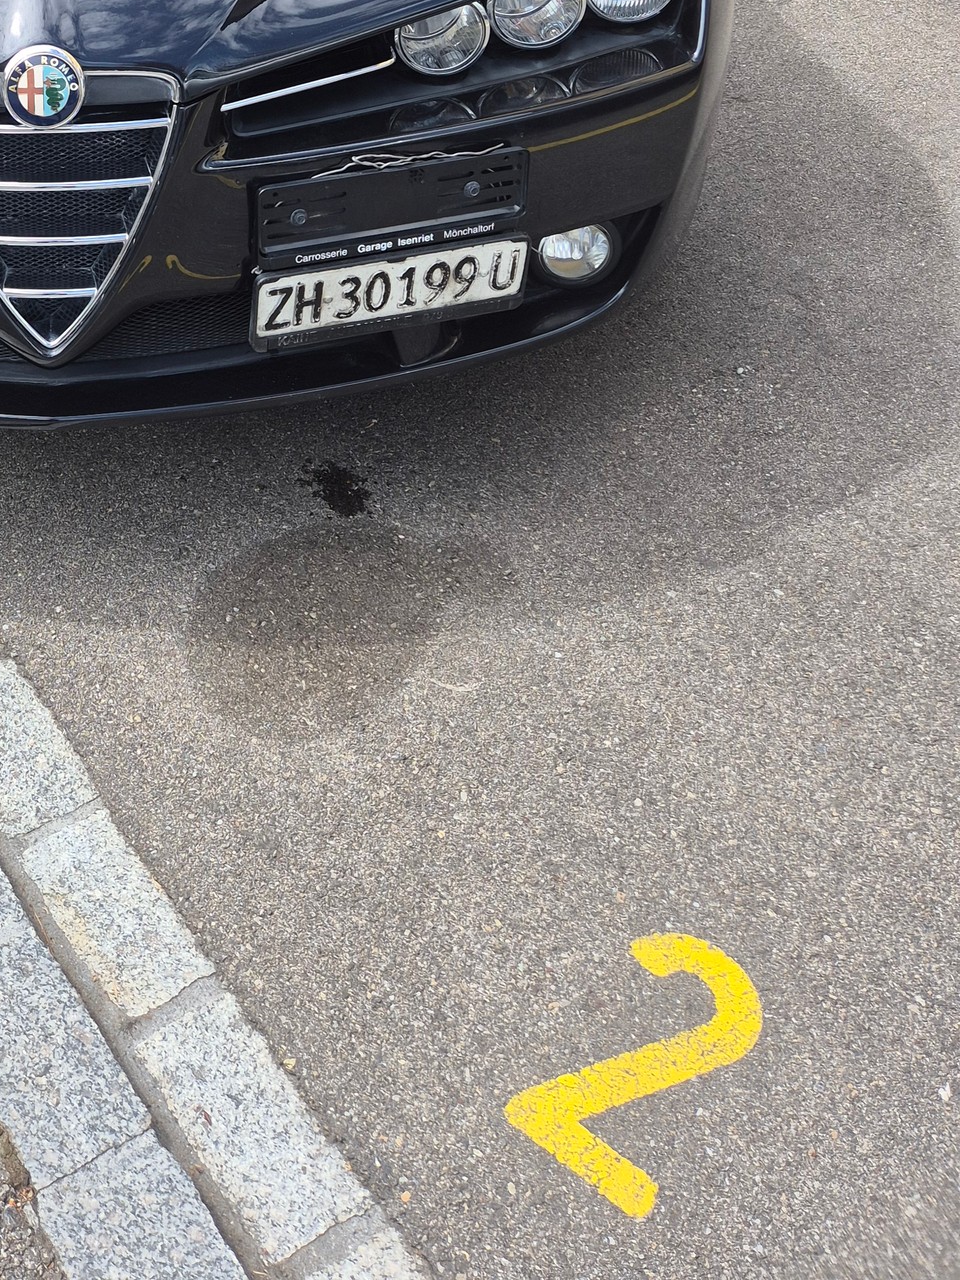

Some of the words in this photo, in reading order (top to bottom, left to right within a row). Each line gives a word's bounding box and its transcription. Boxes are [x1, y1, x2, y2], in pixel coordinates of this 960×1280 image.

[8, 59, 34, 93] ALFA
[41, 55, 79, 91] ROMEO
[295, 248, 348, 264] Carrosserie
[357, 240, 393, 254] Garage
[397, 233, 434, 248] Isenriet
[443, 223, 495, 239] Mönchaltorf
[265, 280, 325, 331] ZH
[333, 255, 481, 320] 30199
[489, 248, 521, 292] U
[503, 931, 763, 1219] 2
